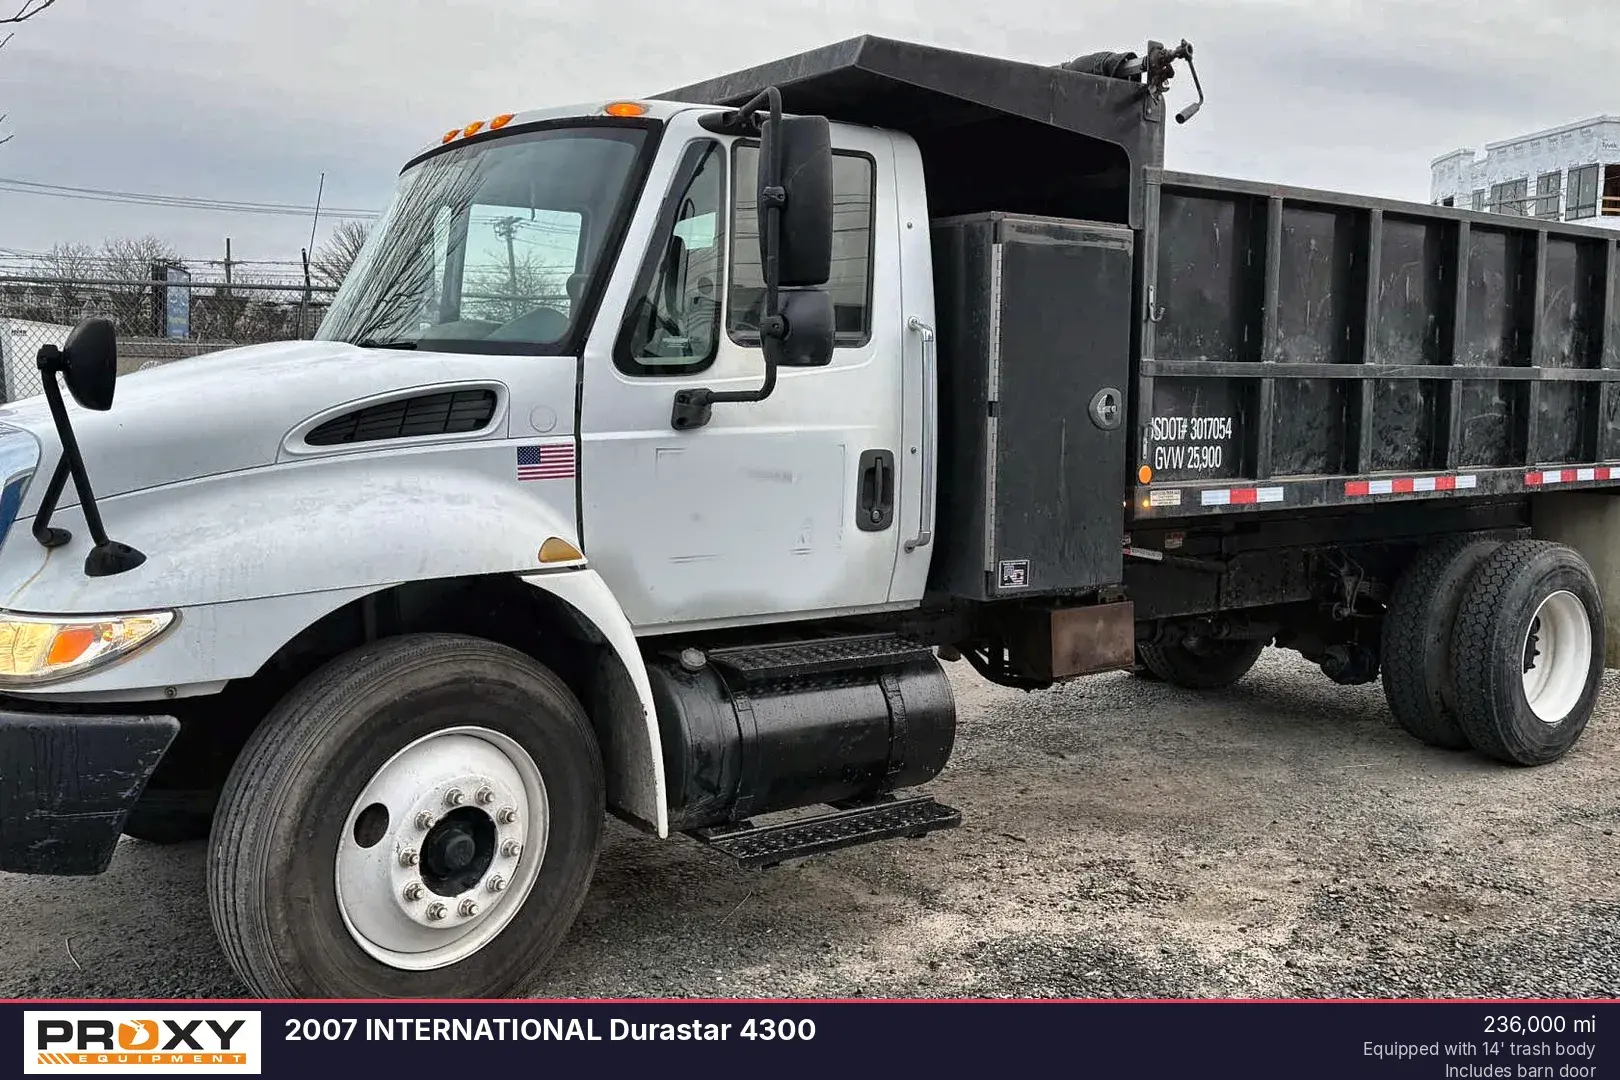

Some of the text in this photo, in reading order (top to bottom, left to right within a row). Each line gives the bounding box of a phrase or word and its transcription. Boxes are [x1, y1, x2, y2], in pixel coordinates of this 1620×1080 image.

[1190, 417, 1232, 440] 3017054
[1155, 445, 1222, 472] GVW 25,900
